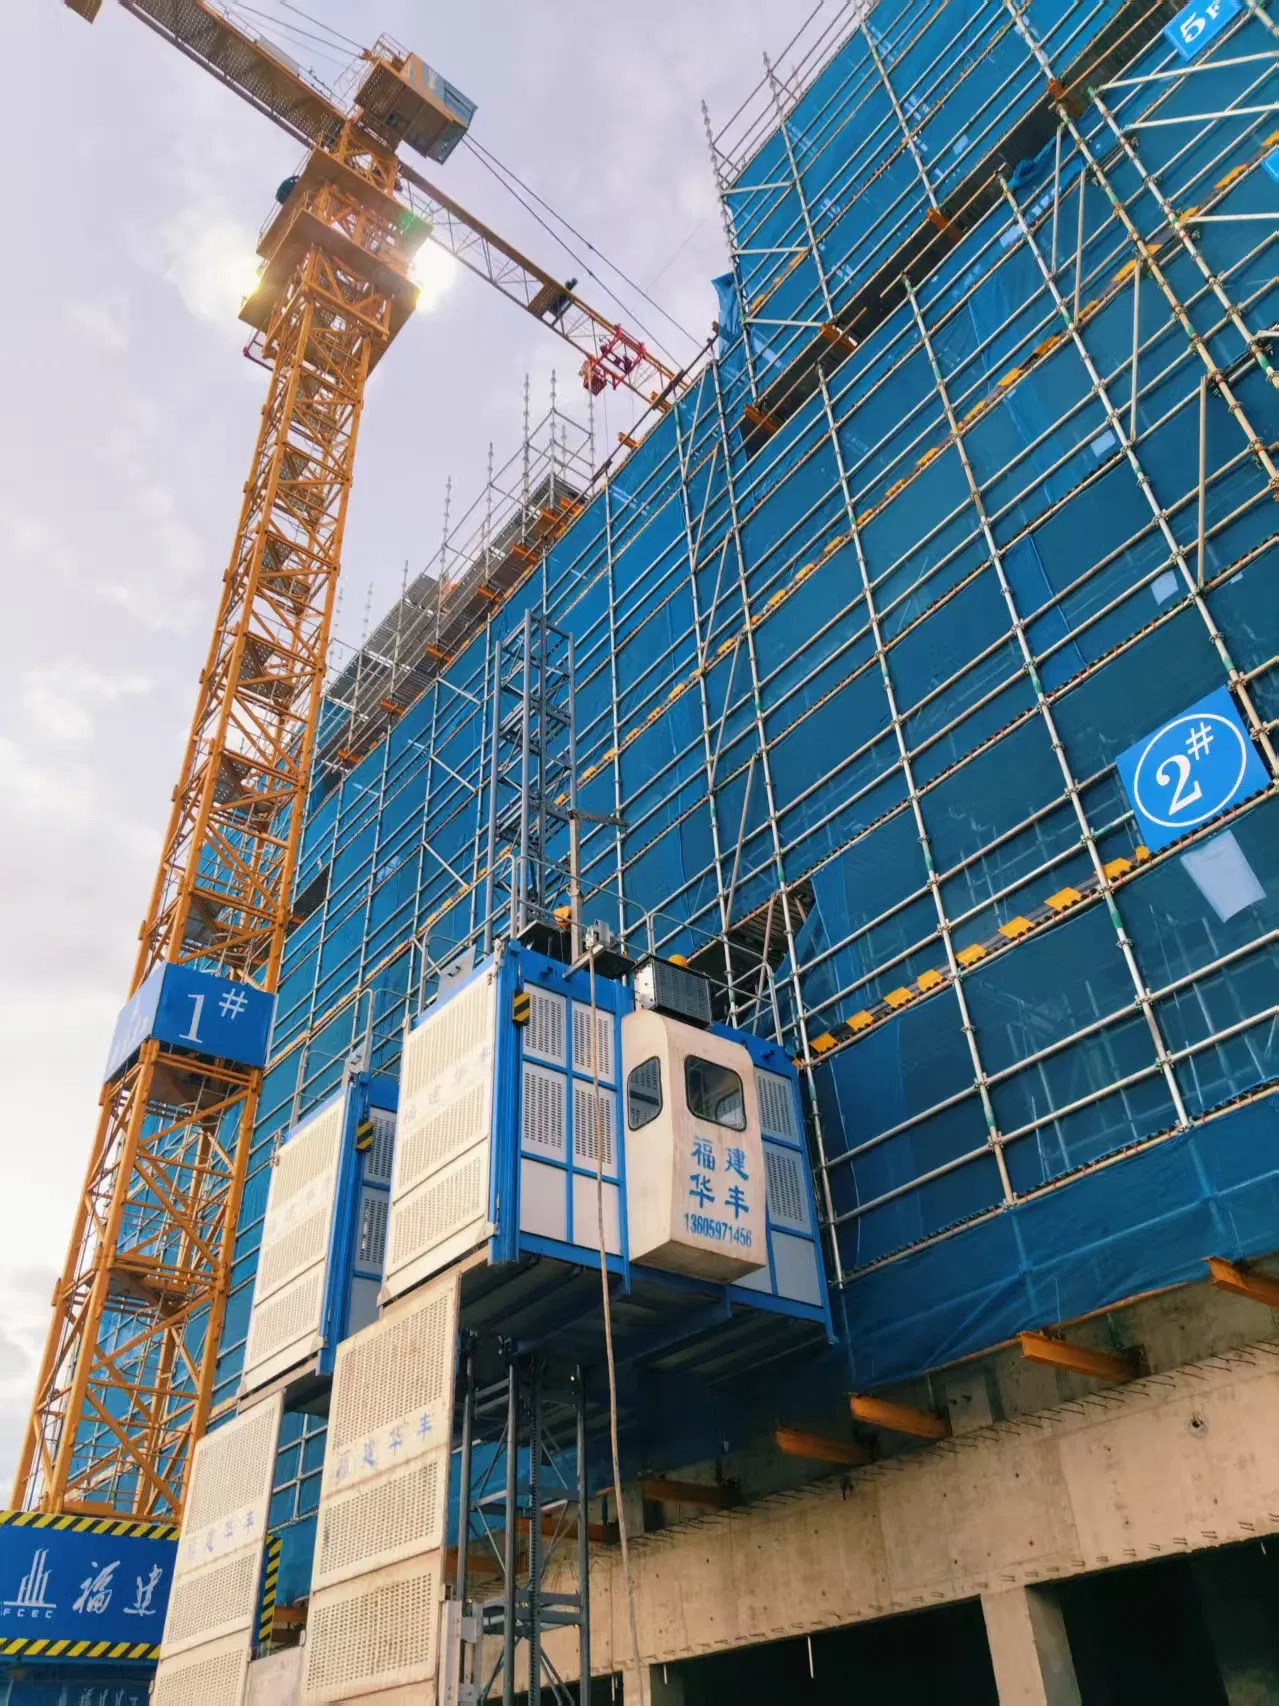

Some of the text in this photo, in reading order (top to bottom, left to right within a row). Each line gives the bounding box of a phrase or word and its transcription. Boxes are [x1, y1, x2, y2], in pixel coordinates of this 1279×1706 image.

[1156, 721, 1214, 816] 2#
[178, 988, 249, 1044] 1#
[690, 1136, 749, 1181] 福建
[689, 1174, 749, 1220] 华丰
